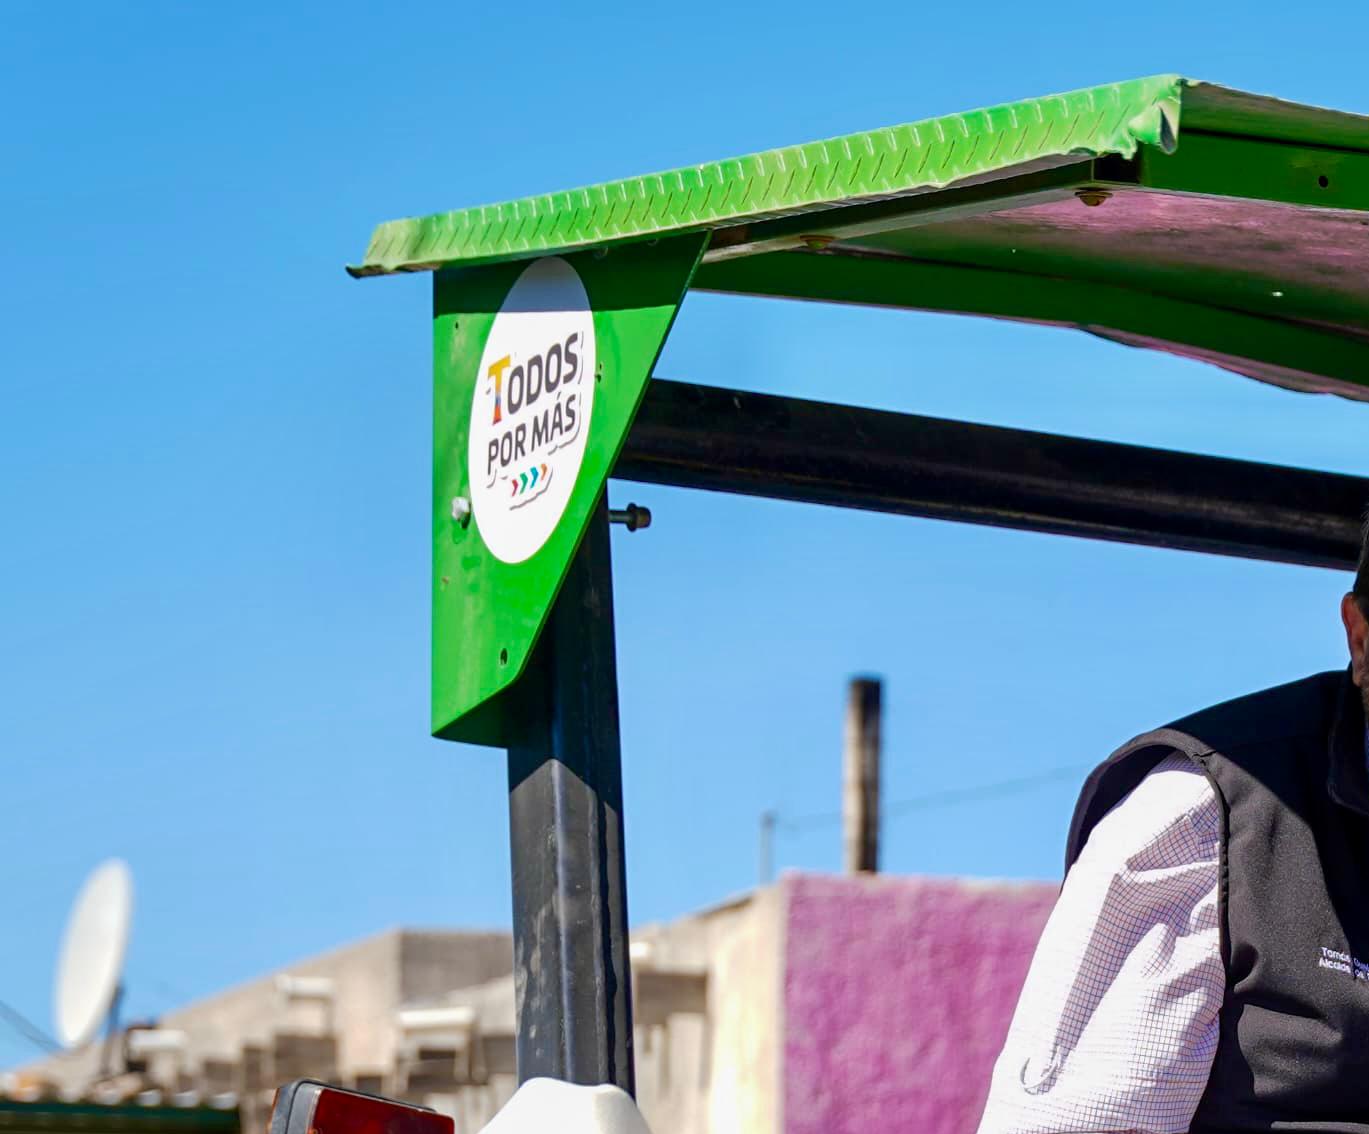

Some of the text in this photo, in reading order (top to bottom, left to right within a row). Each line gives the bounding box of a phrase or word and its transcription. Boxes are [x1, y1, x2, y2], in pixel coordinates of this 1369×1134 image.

[487, 332, 579, 426] TODOS
[487, 391, 577, 475] POR MÁS
